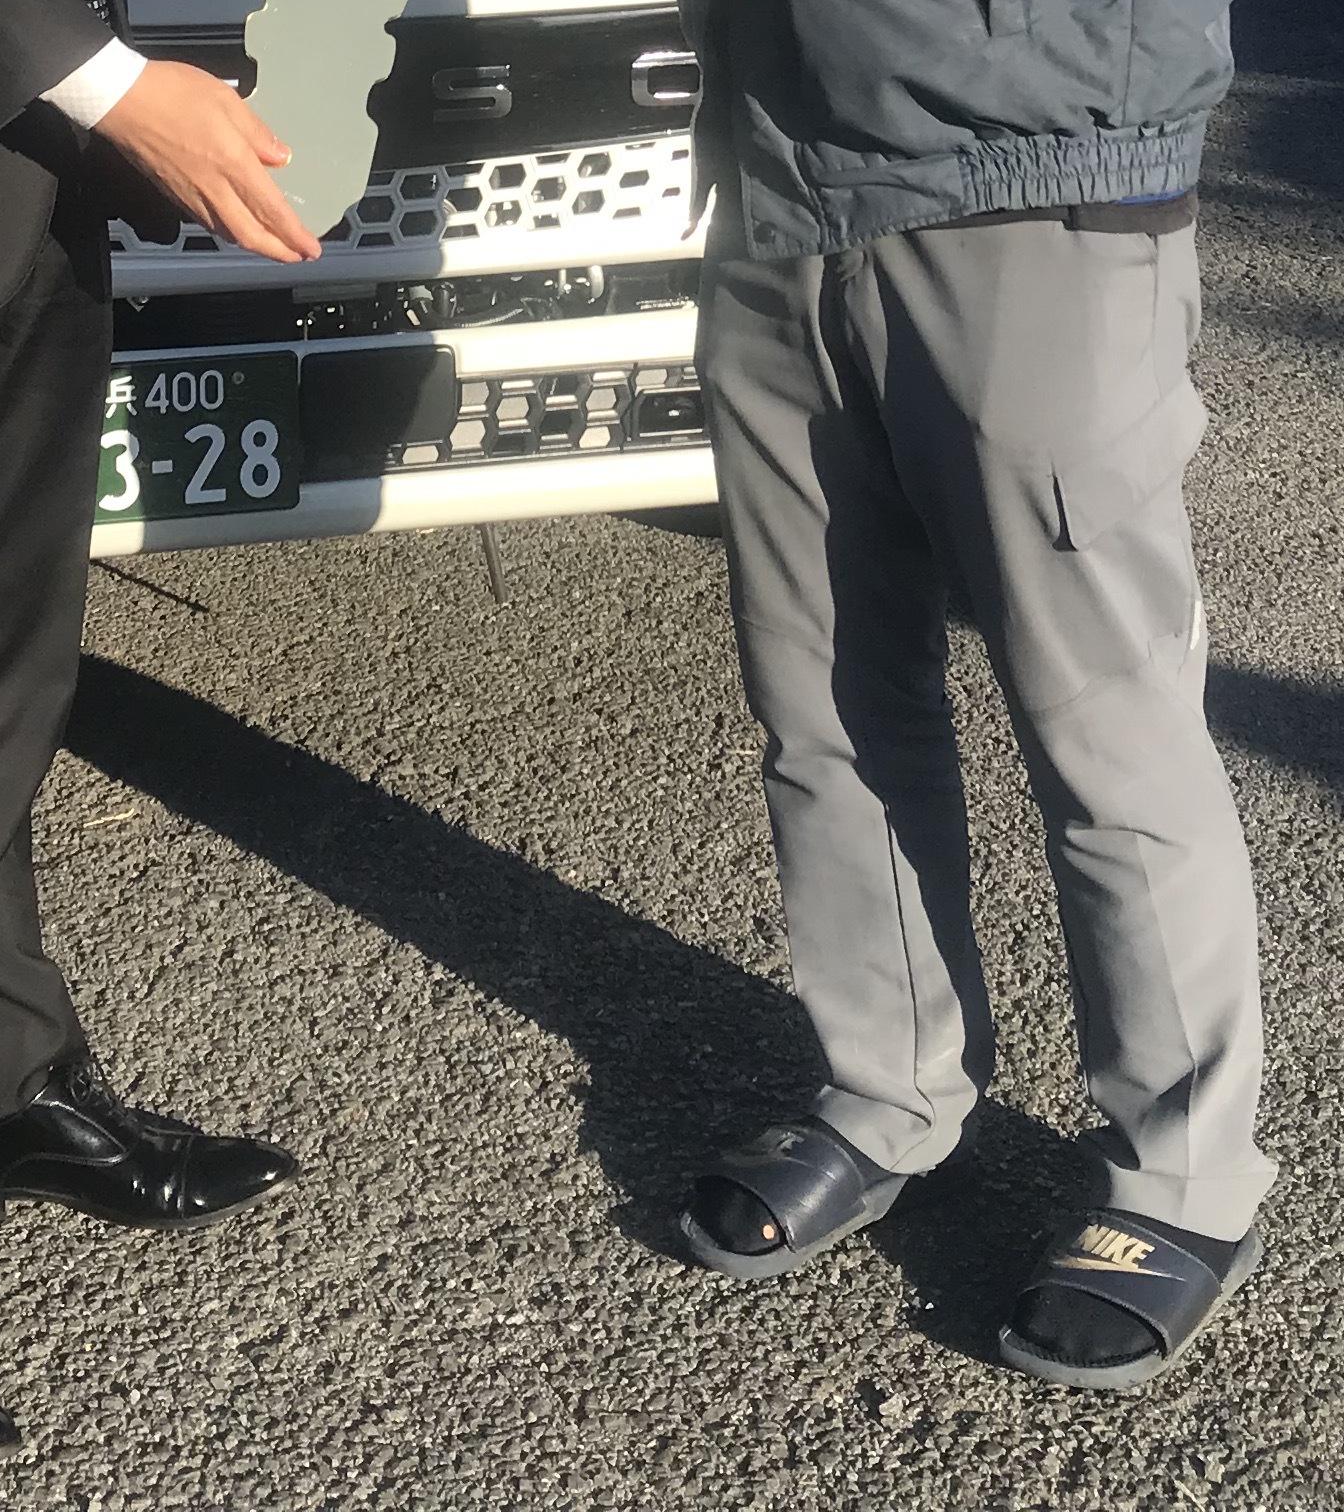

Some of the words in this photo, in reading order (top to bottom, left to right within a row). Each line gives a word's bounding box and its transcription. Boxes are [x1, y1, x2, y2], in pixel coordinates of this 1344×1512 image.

[144, 369, 225, 415] 400
[98, 418, 282, 512] 3-28
[1073, 1223, 1156, 1269] NIKE
